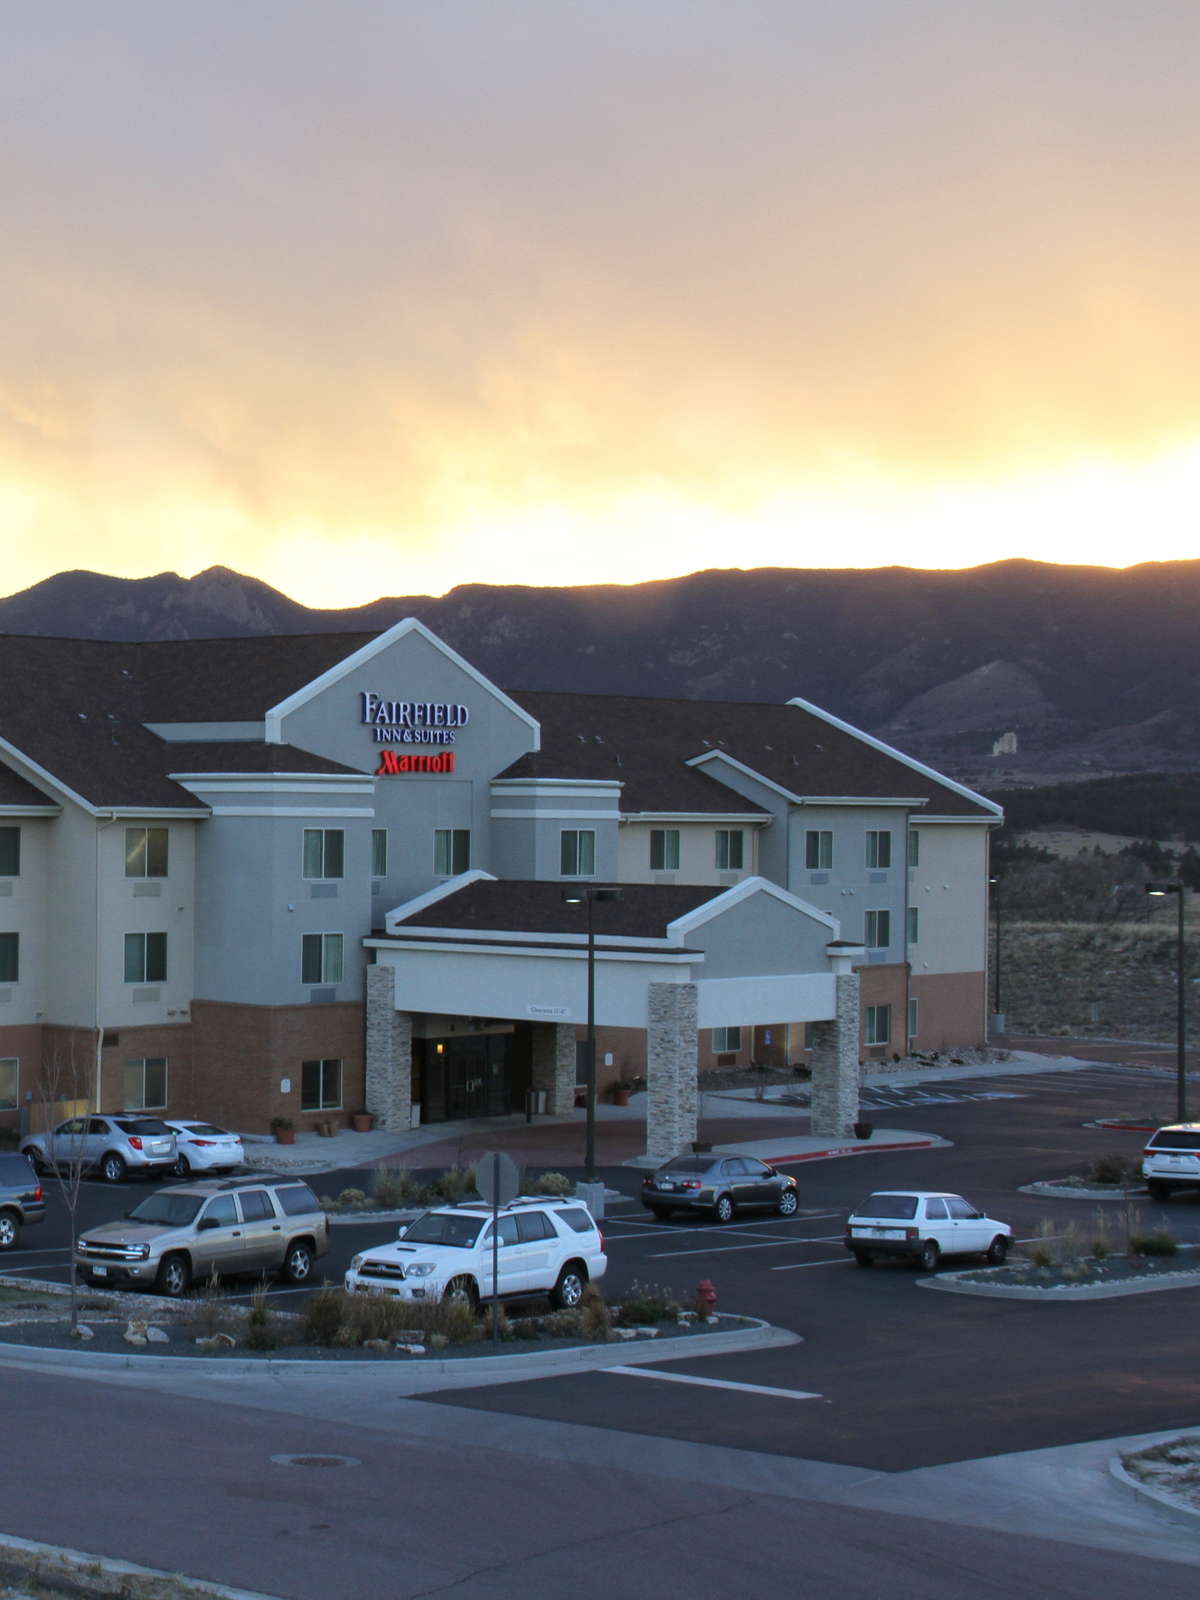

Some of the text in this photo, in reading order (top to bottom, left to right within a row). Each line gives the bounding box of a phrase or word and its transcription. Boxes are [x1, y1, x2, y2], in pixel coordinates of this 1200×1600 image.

[361, 691, 470, 728] FAIRFIELD
[375, 728, 401, 743] INN
[414, 729, 457, 745] SUITES
[376, 750, 456, 775] Marriott
